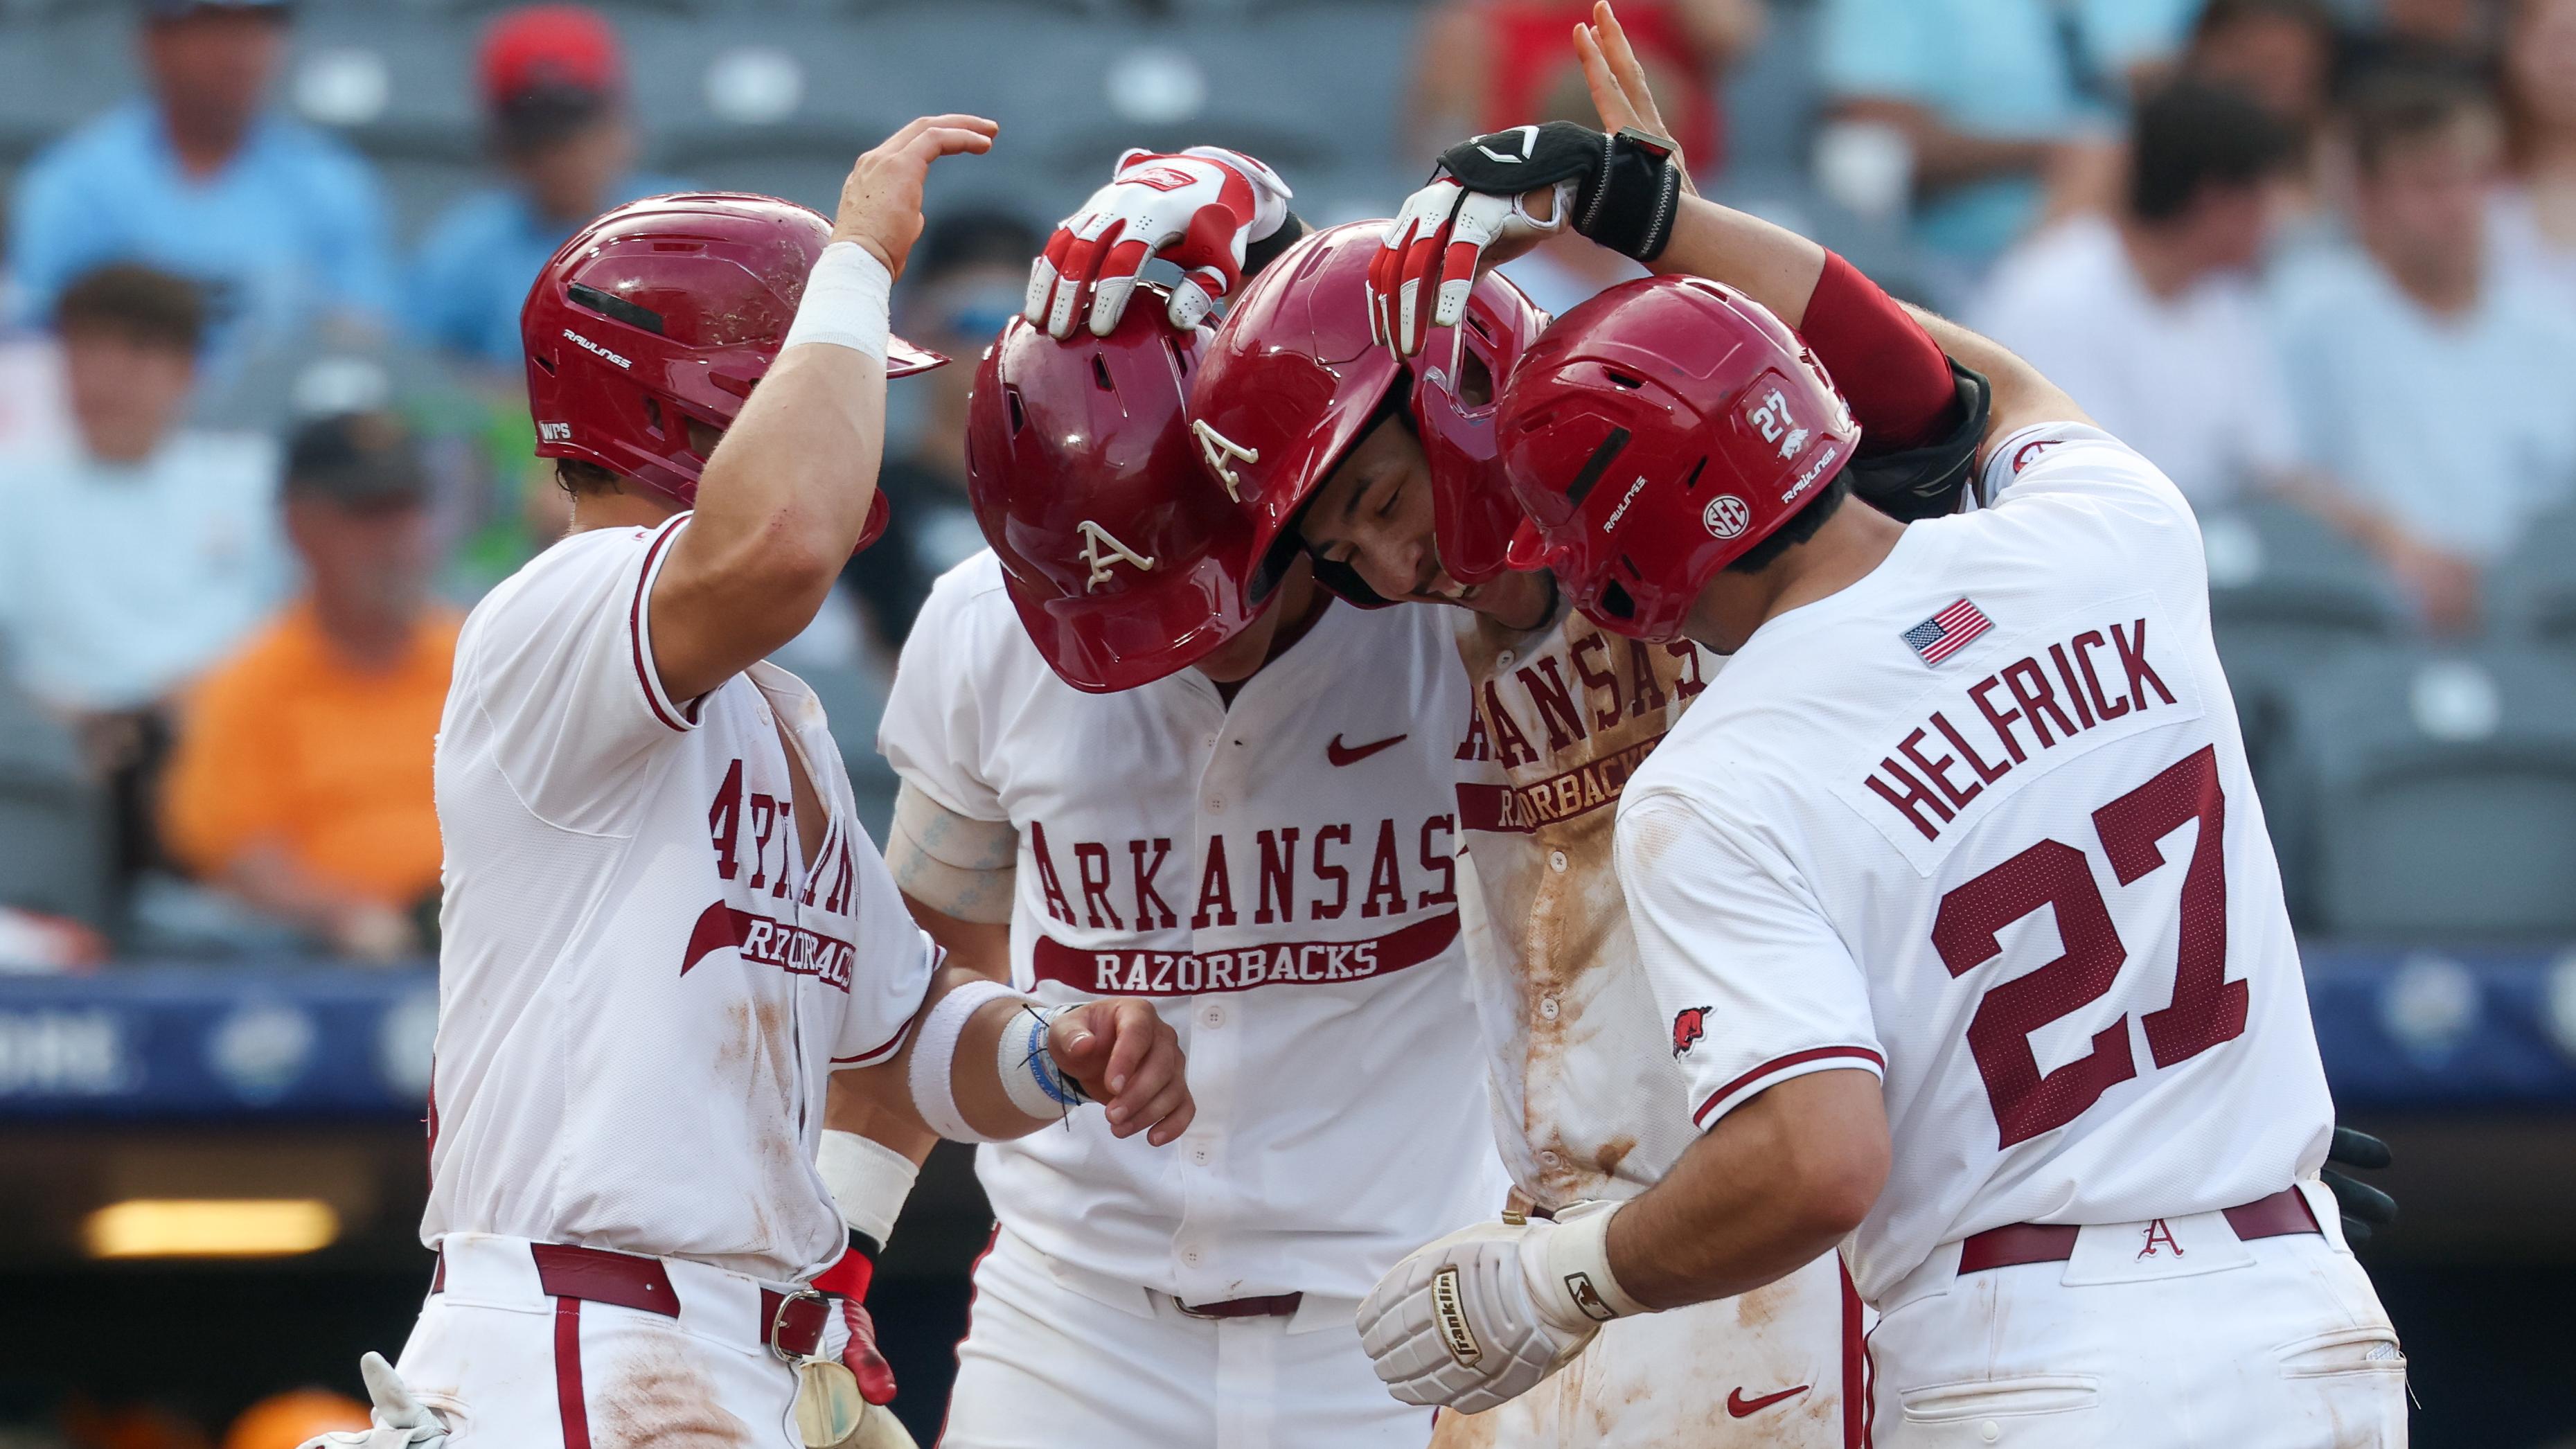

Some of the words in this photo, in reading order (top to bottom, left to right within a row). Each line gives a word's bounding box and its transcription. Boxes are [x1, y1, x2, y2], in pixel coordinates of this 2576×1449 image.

[562, 328, 632, 369] RAWLINGS
[541, 422, 571, 440] WPS
[1752, 389, 1793, 444] 27
[1603, 475, 1647, 533] RAWLINGS
[1781, 446, 1837, 504] RAWLINGS
[1706, 497, 1747, 537] SEC
[1076, 519, 1155, 594] A
[1863, 617, 2178, 843] HELFRICK
[1031, 813, 1457, 932] ARKANSAS
[1094, 941, 1378, 993] RAZORBACKS
[1930, 743, 2250, 1153] 27
